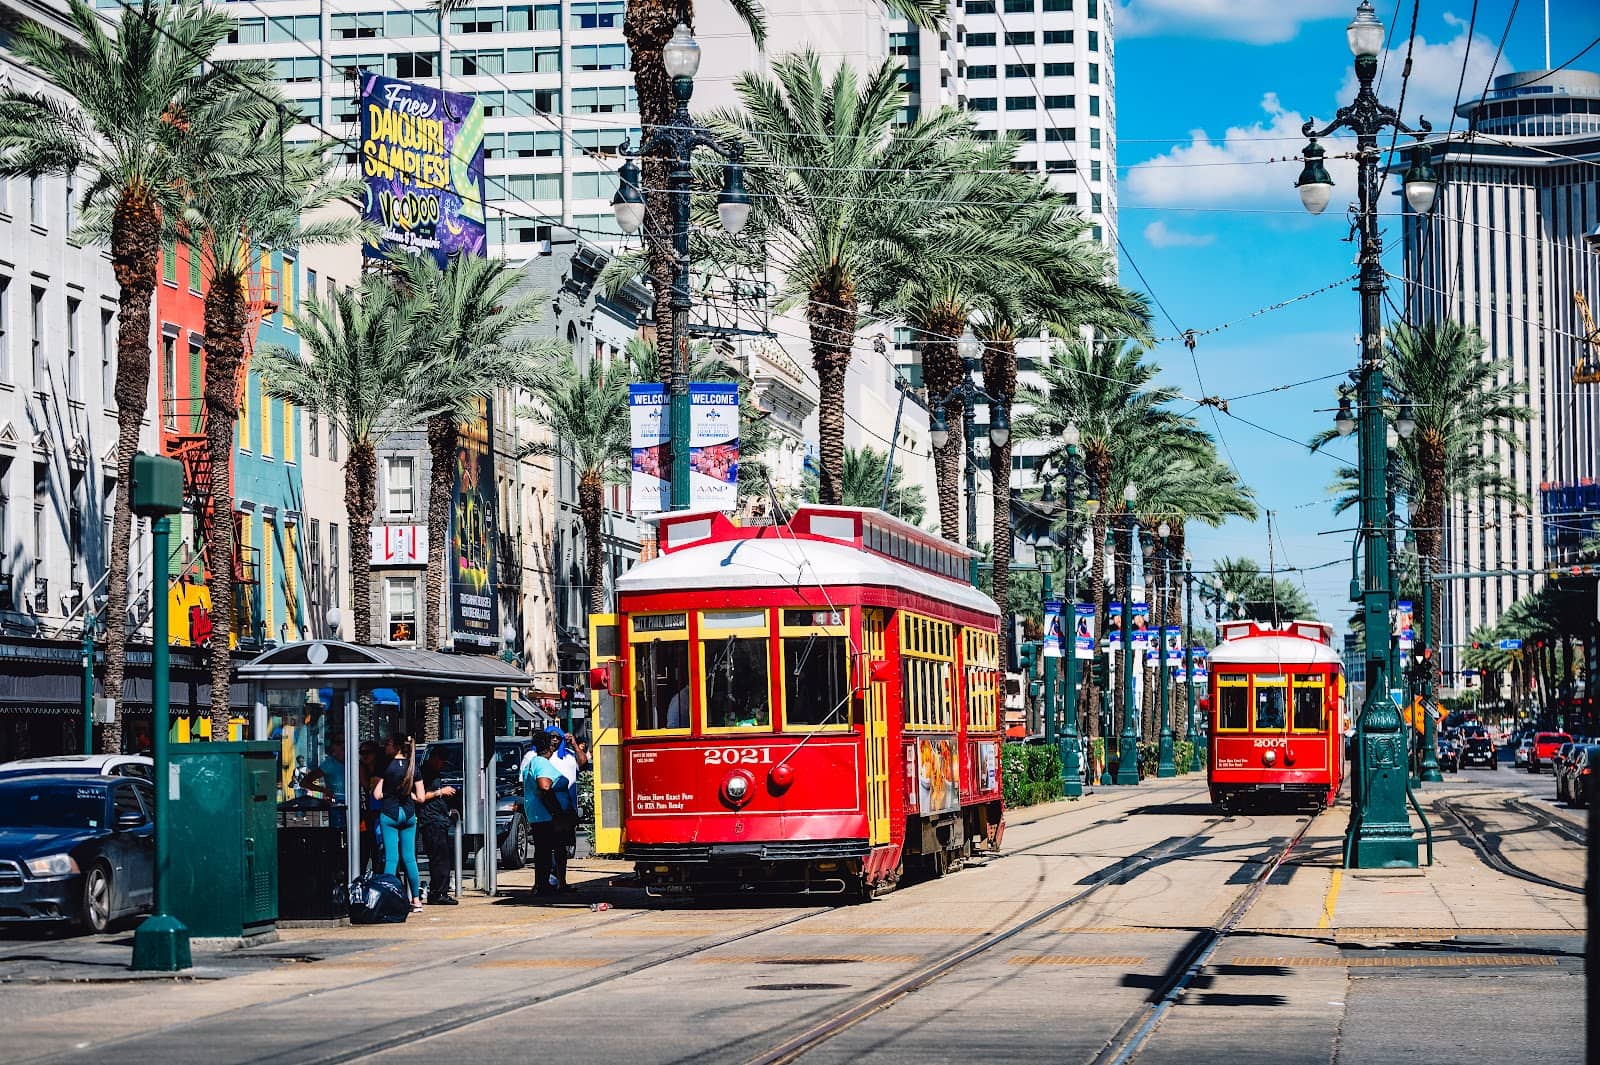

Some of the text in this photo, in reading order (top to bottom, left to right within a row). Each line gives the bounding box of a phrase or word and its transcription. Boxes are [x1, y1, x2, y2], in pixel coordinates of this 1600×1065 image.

[384, 83, 437, 118] Free
[369, 103, 444, 155] DAIQUIRI
[364, 140, 450, 191] SAMPLES!
[379, 190, 439, 229] VOODOO
[634, 394, 671, 405] WELCOM
[692, 394, 734, 404] WELCOME
[1254, 738, 1287, 748] 2007
[704, 748, 773, 765] 2021
[668, 801, 684, 811] Ready
